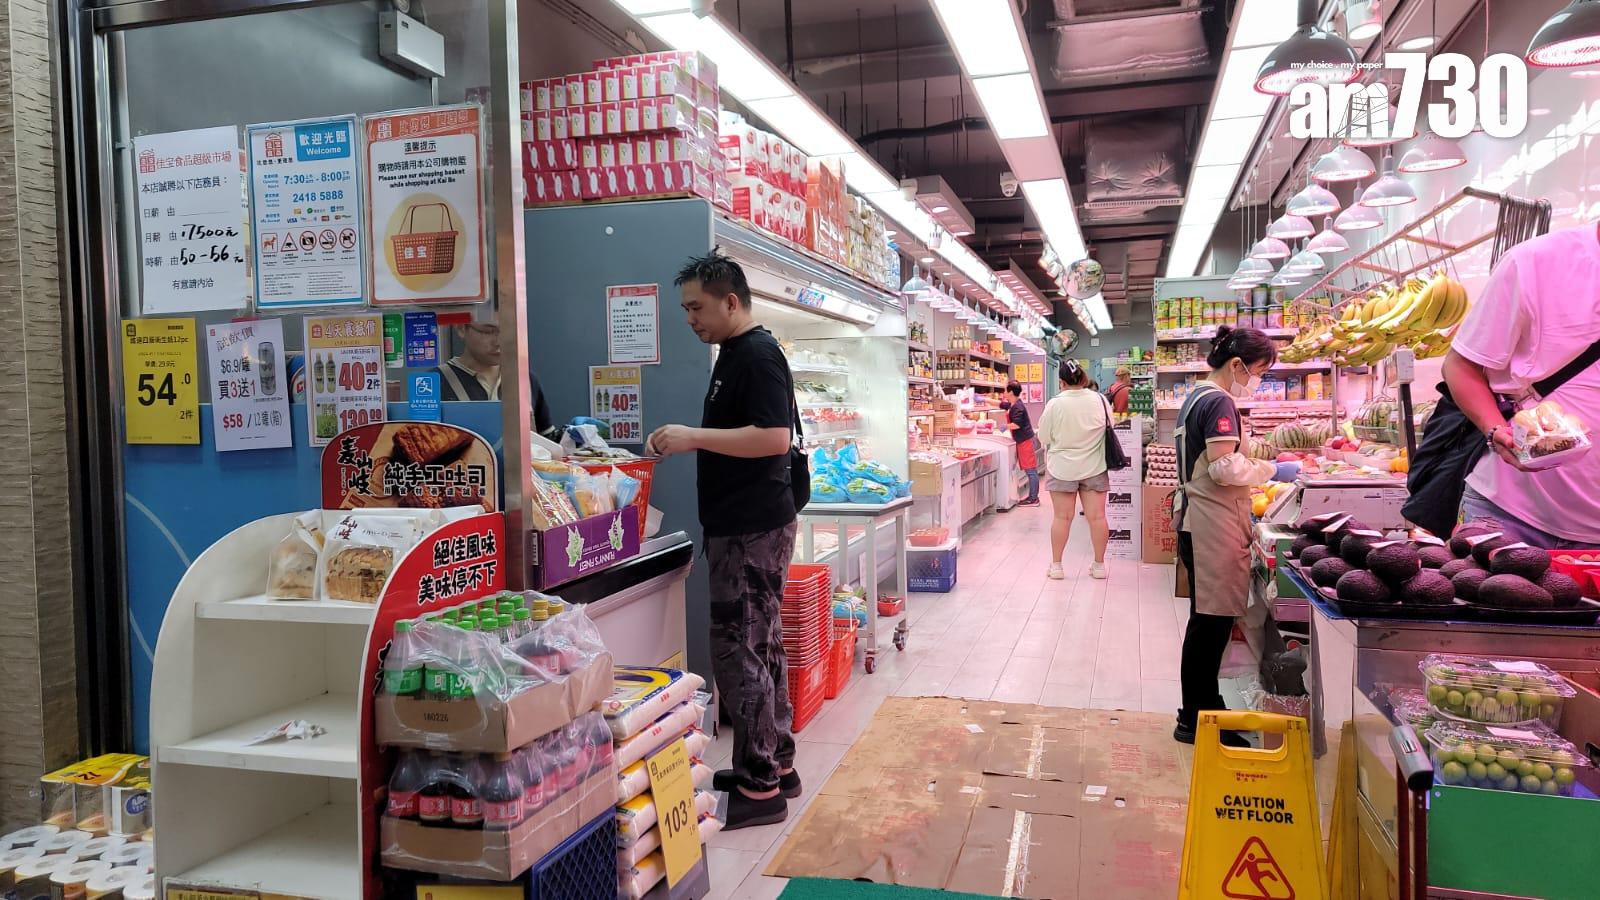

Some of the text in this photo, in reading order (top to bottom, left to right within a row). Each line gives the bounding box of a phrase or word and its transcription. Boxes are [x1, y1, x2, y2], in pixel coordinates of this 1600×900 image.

[299, 130, 347, 146] 歡迎光臨
[306, 146, 342, 156] Welcome
[404, 141, 436, 152] 溫馨提示
[284, 174, 305, 185] 7:30
[321, 171, 342, 182] 8:00
[378, 174, 397, 182] Please
[418, 170, 444, 179] shopping
[444, 168, 465, 176] basket
[405, 179, 429, 188] shopping
[292, 192, 317, 203] 2418
[319, 190, 344, 201] 5888
[167, 206, 175, 217] 由
[169, 231, 177, 240] 由
[170, 257, 179, 266] 由
[339, 362, 365, 391] 40
[367, 378, 381, 390] 2件
[138, 372, 191, 406] 54 .0
[218, 377, 256, 400] 買3送1
[612, 393, 629, 411] 40
[180, 409, 194, 420] 2件
[223, 413, 243, 431] $58
[612, 422, 630, 439] 139
[383, 462, 486, 487] 純手工吐司
[433, 529, 497, 569] 絕佳風味
[417, 561, 498, 606] 美味停不下
[1223, 794, 1285, 810] CAUTION
[664, 799, 689, 839] 103
[1215, 807, 1294, 824] WET FLOOR
